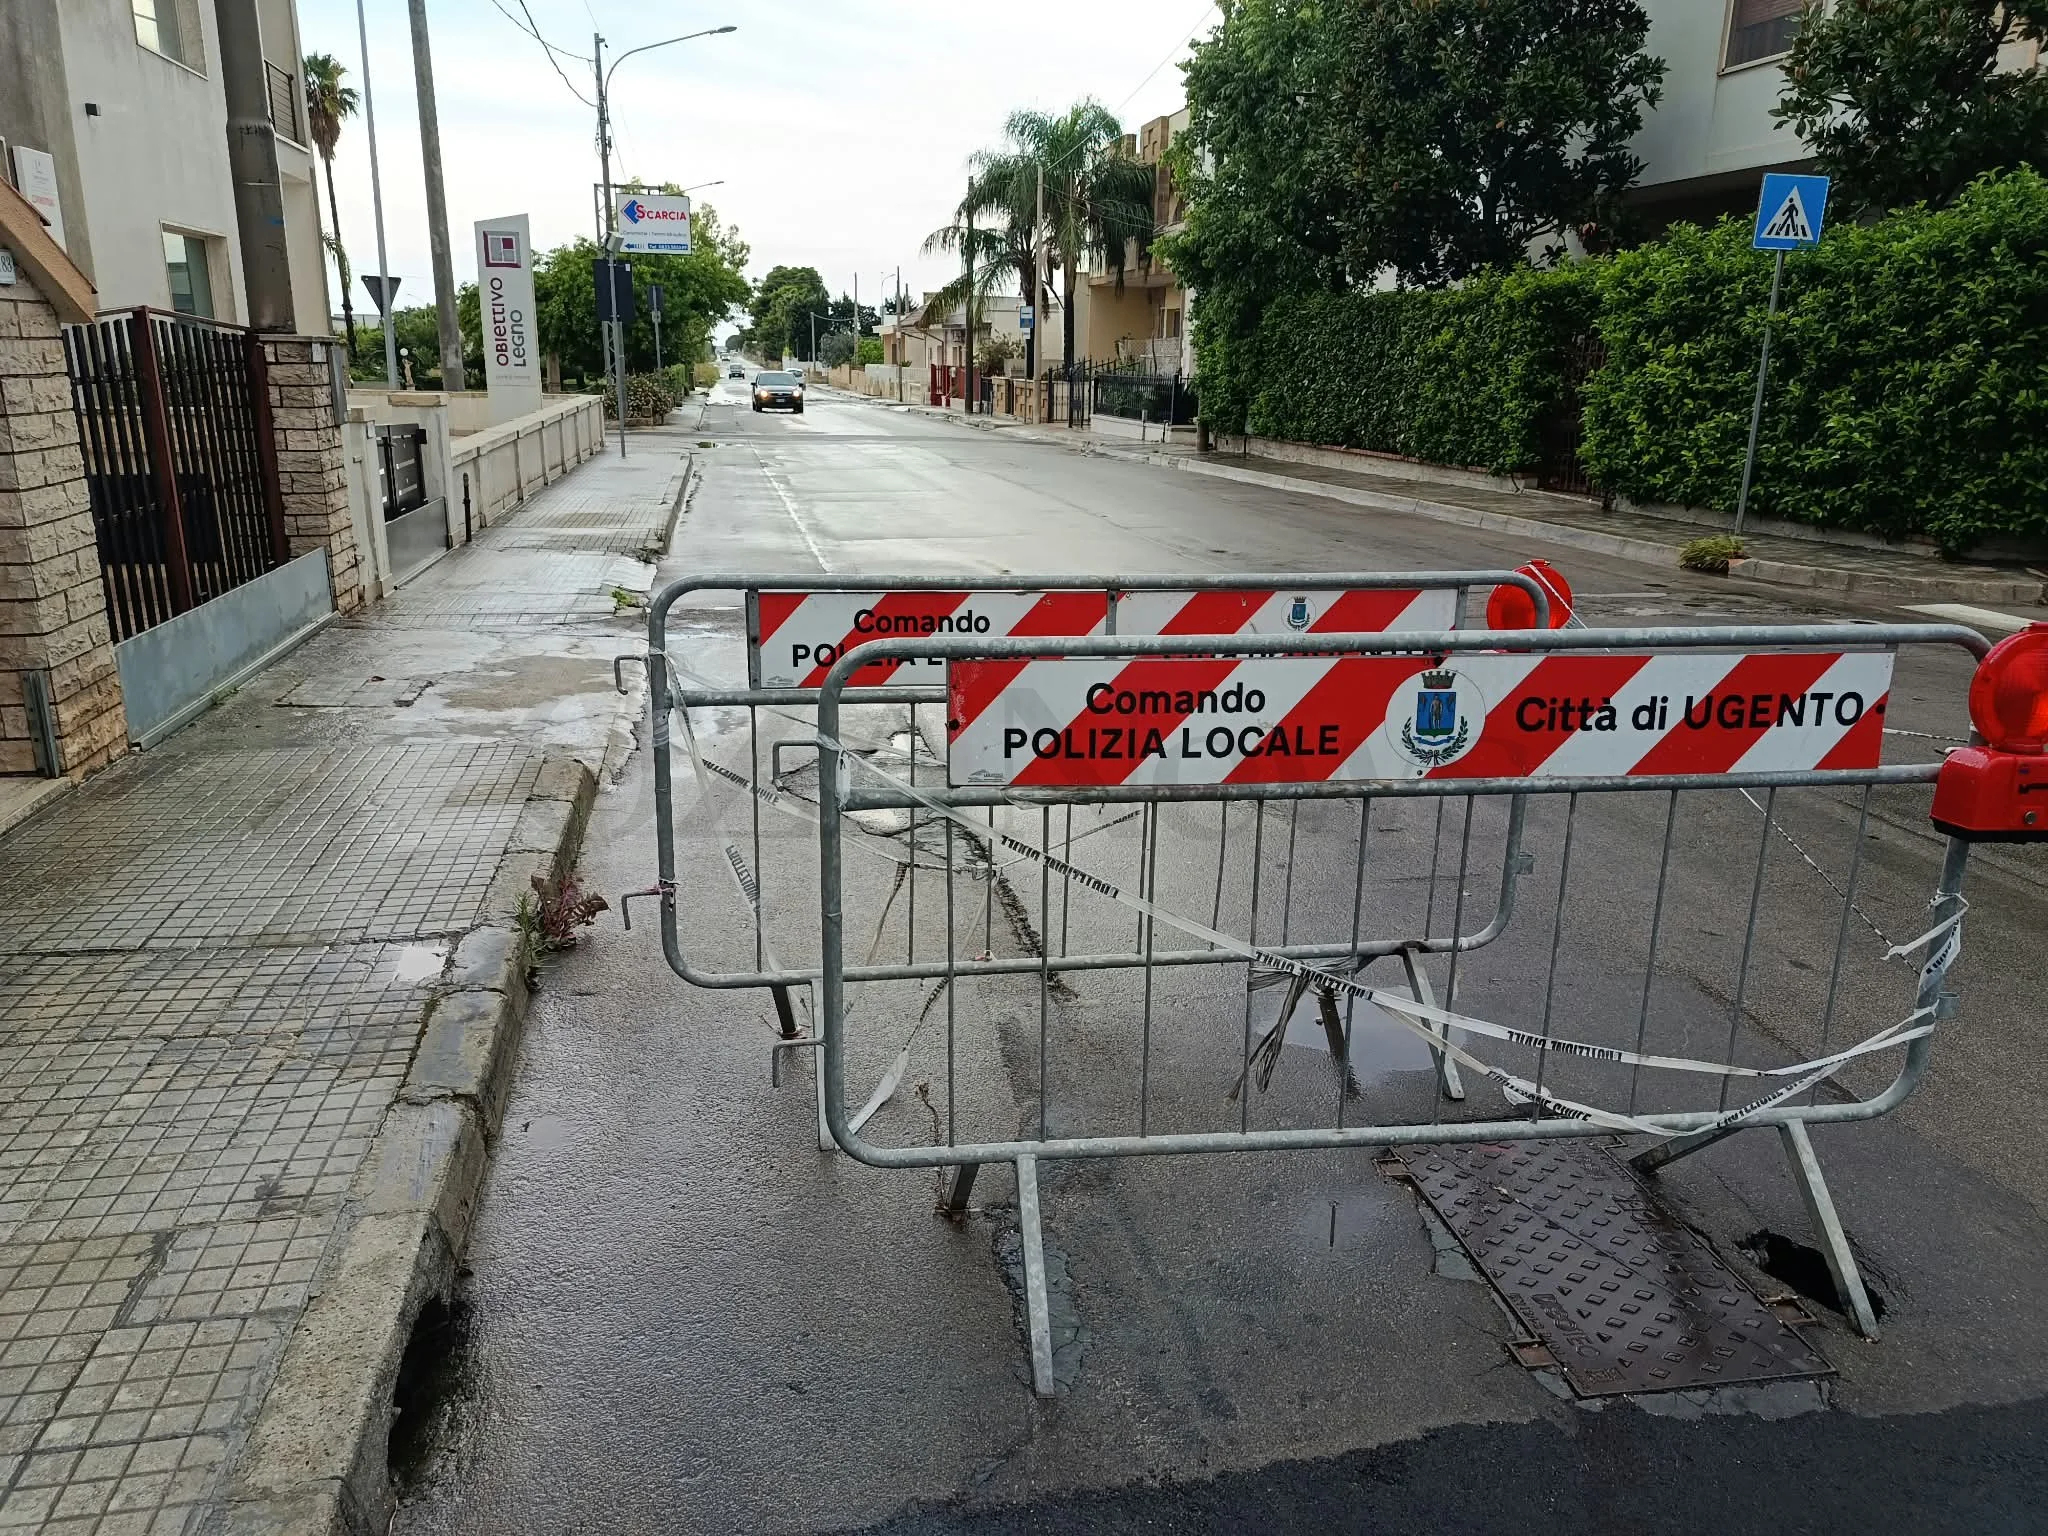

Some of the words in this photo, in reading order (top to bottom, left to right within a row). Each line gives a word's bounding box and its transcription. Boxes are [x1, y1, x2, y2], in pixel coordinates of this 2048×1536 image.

[636, 205, 687, 221] SCARCIA
[853, 608, 991, 635] Comando
[1086, 682, 1266, 715] Comando
[1516, 695, 1618, 733] Città
[1631, 695, 1668, 732] di
[1684, 690, 1864, 730] UGENTO
[1003, 726, 1167, 760] POLIZIA
[1181, 724, 1339, 758] LOCALE
